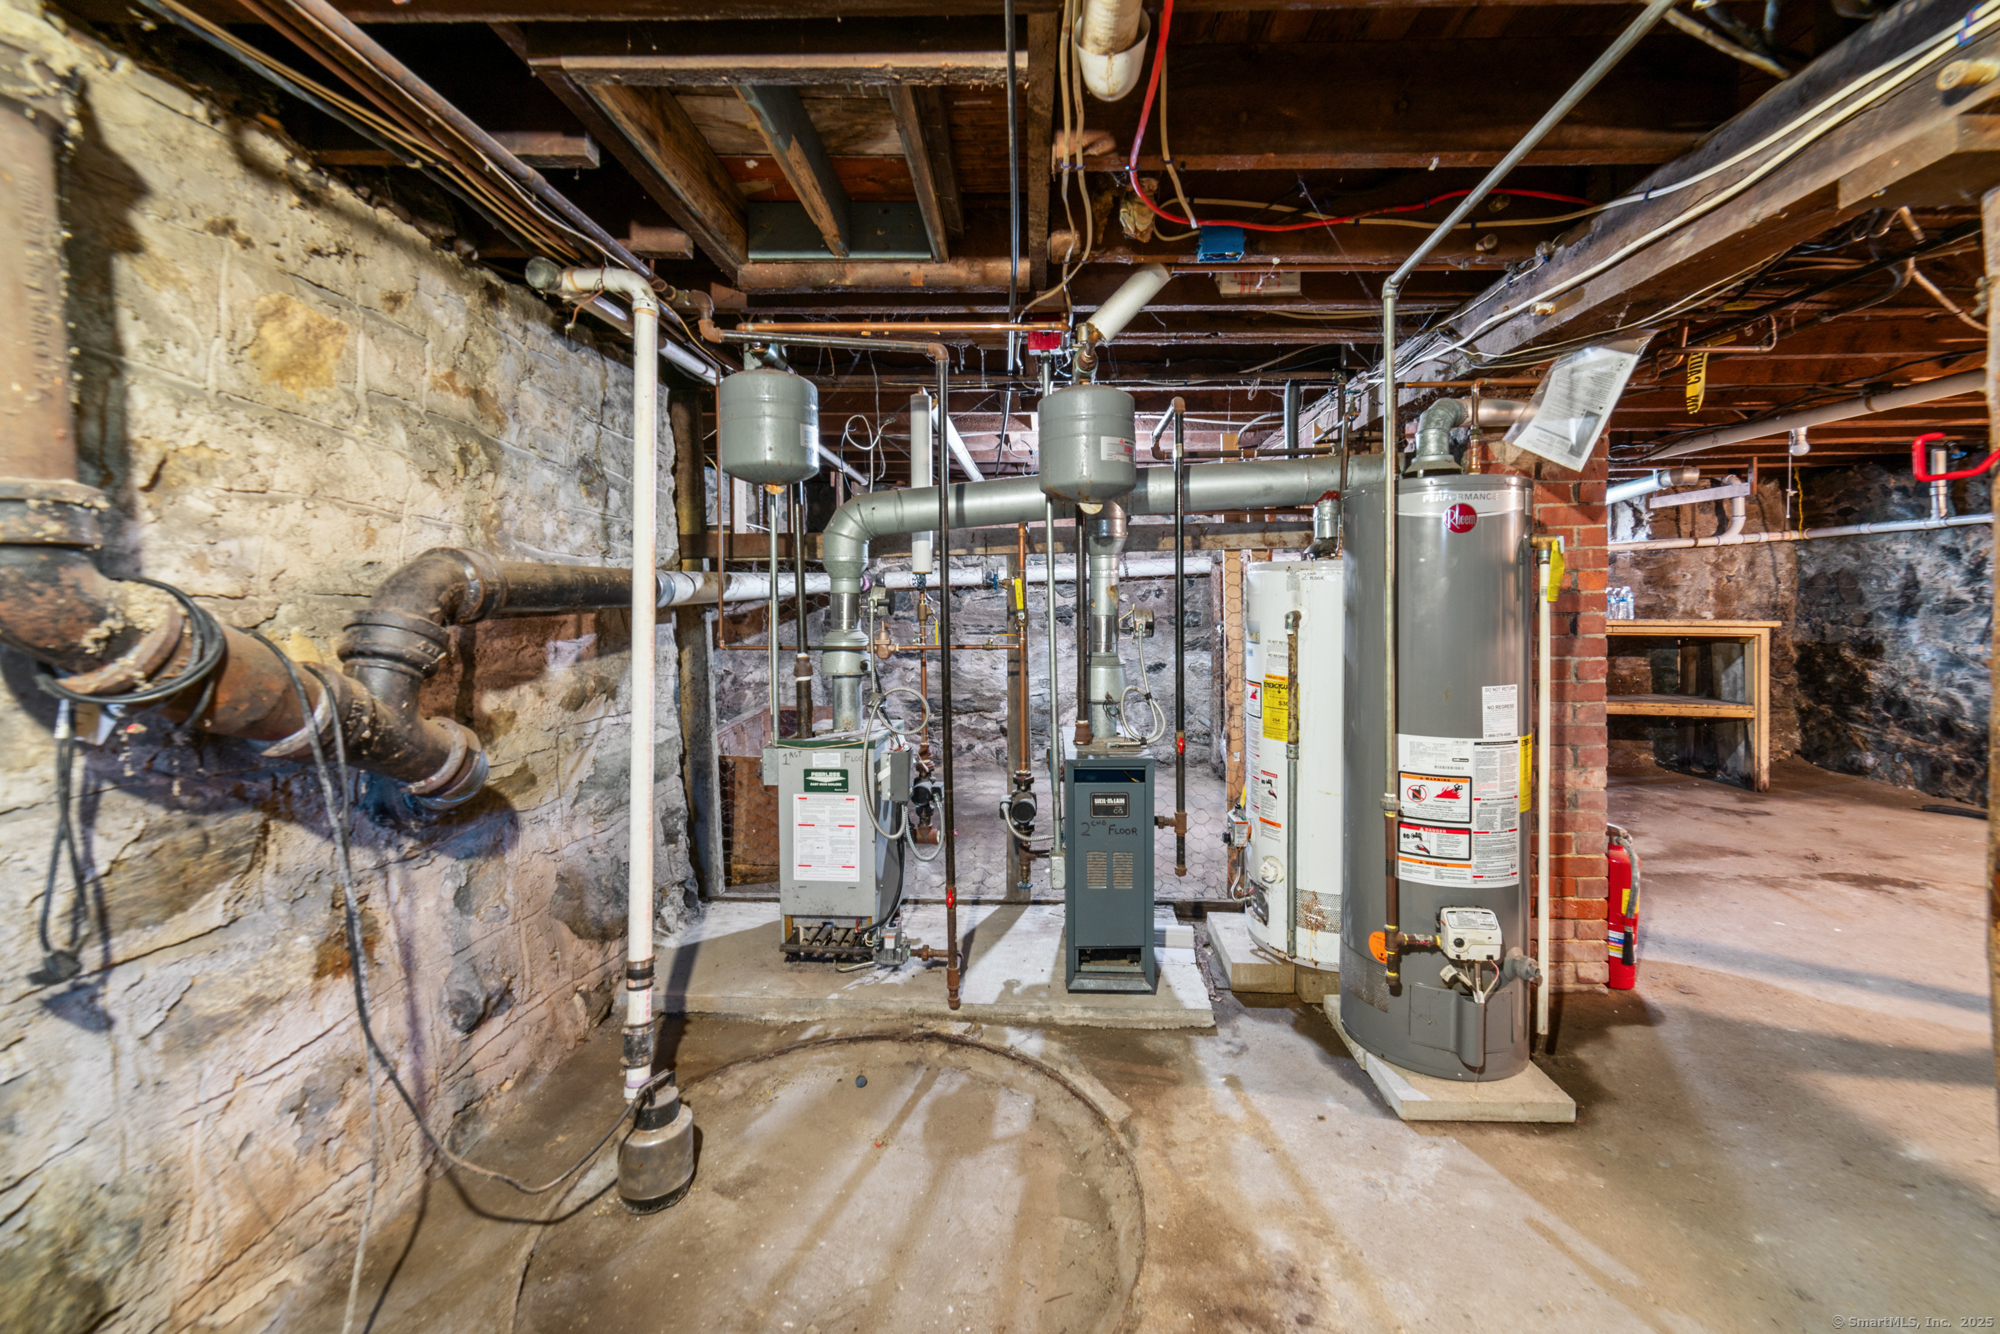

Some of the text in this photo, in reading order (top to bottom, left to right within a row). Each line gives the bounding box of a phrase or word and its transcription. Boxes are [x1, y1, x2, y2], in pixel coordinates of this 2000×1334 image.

[1422, 492, 1497, 503] PERFORMANCE
[1446, 504, 1476, 530] Rheem
[1108, 824, 1138, 837] FLOOR
